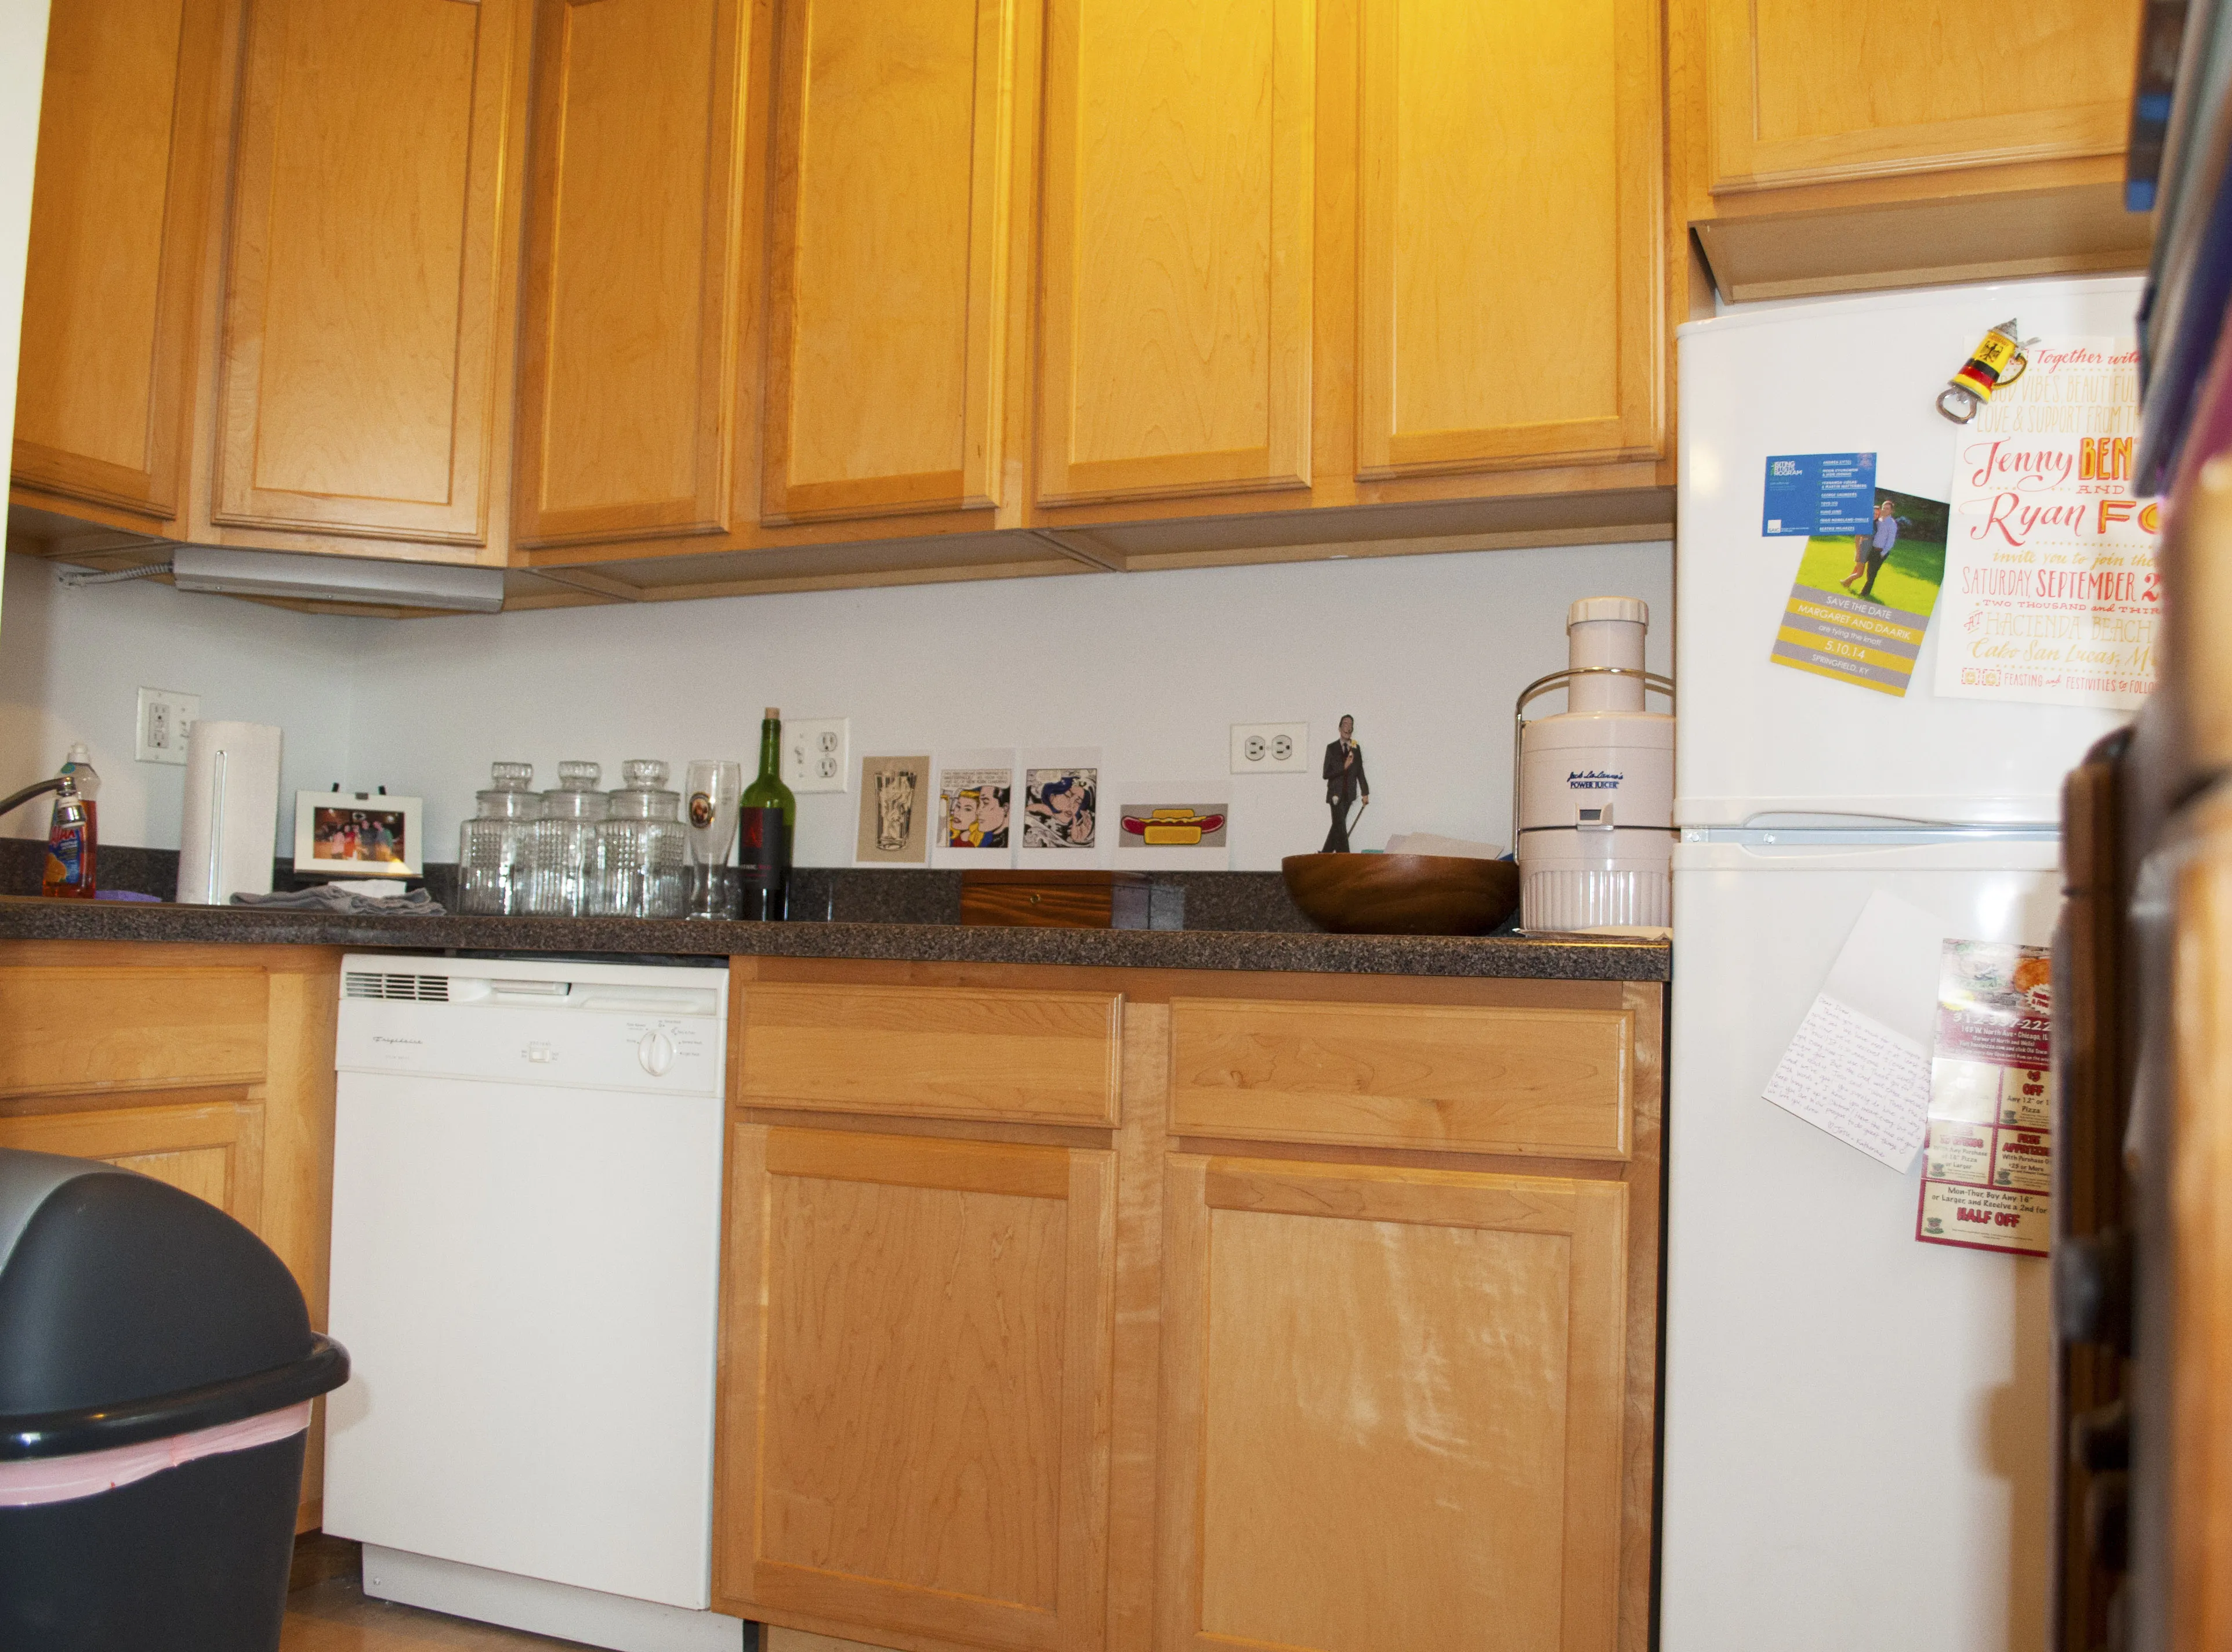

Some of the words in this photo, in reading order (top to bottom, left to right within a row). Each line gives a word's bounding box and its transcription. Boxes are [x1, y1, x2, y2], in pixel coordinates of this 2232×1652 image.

[2035, 348, 2104, 374] Together
[2066, 375, 2136, 403] BEAUTIFUL
[1977, 406, 2010, 433] LOVE
[2013, 407, 2024, 432] &
[2027, 405, 2084, 433] SUPPORT
[2086, 405, 2122, 433] FROM
[1964, 436, 2073, 492] Jenny
[2078, 436, 2139, 481] BEN
[2076, 485, 2125, 494] AND
[1959, 492, 2086, 546] Ryan
[1992, 549, 2037, 563] invite
[2043, 553, 2067, 565] you
[2071, 552, 2088, 564] to
[2089, 552, 2124, 571] join
[1962, 567, 2032, 598] SATURDAY,
[2036, 568, 2136, 602] SEPTEMBER
[1827, 596, 1850, 608] SAVE
[1851, 602, 1867, 613] THE
[1868, 606, 1893, 620] DATE
[1983, 599, 2012, 607] TWO
[2017, 601, 2086, 611] THOUSAND
[2090, 603, 2116, 613] and
[1798, 604, 1850, 624] MARGARET
[1851, 619, 1873, 630] AND
[1874, 624, 1912, 640] DAARIK
[1963, 611, 1984, 631] AT
[1985, 611, 2082, 639] HACIENDA
[2091, 616, 2153, 644] BEACH
[1831, 628, 1849, 639] tying
[1850, 632, 1862, 640] the
[1825, 640, 1866, 660] 5.10.14
[1967, 637, 2020, 658] Cabo
[2023, 640, 2060, 661] San
[2064, 644, 2119, 667] Lucas,
[1859, 666, 1869, 675] KY
[2004, 673, 2043, 687] FEASTING
[2045, 676, 2061, 687] and
[2066, 676, 2116, 692] FESTIVITIES
[2118, 680, 2128, 691] to
[1567, 771, 1584, 782] Jack
[1984, 1028, 2001, 1036] North
[2018, 1031, 2041, 1040] Chicago,
[2023, 1084, 2044, 1096] OFF
[1962, 1149, 1987, 1157] Purchase
[1983, 1200, 2011, 1210] Receive
[1987, 1191, 2000, 1200] Buy
[2002, 1194, 2017, 1202] Any
[1957, 1207, 1992, 1224] HALF
[1994, 1211, 2020, 1228] OFF
